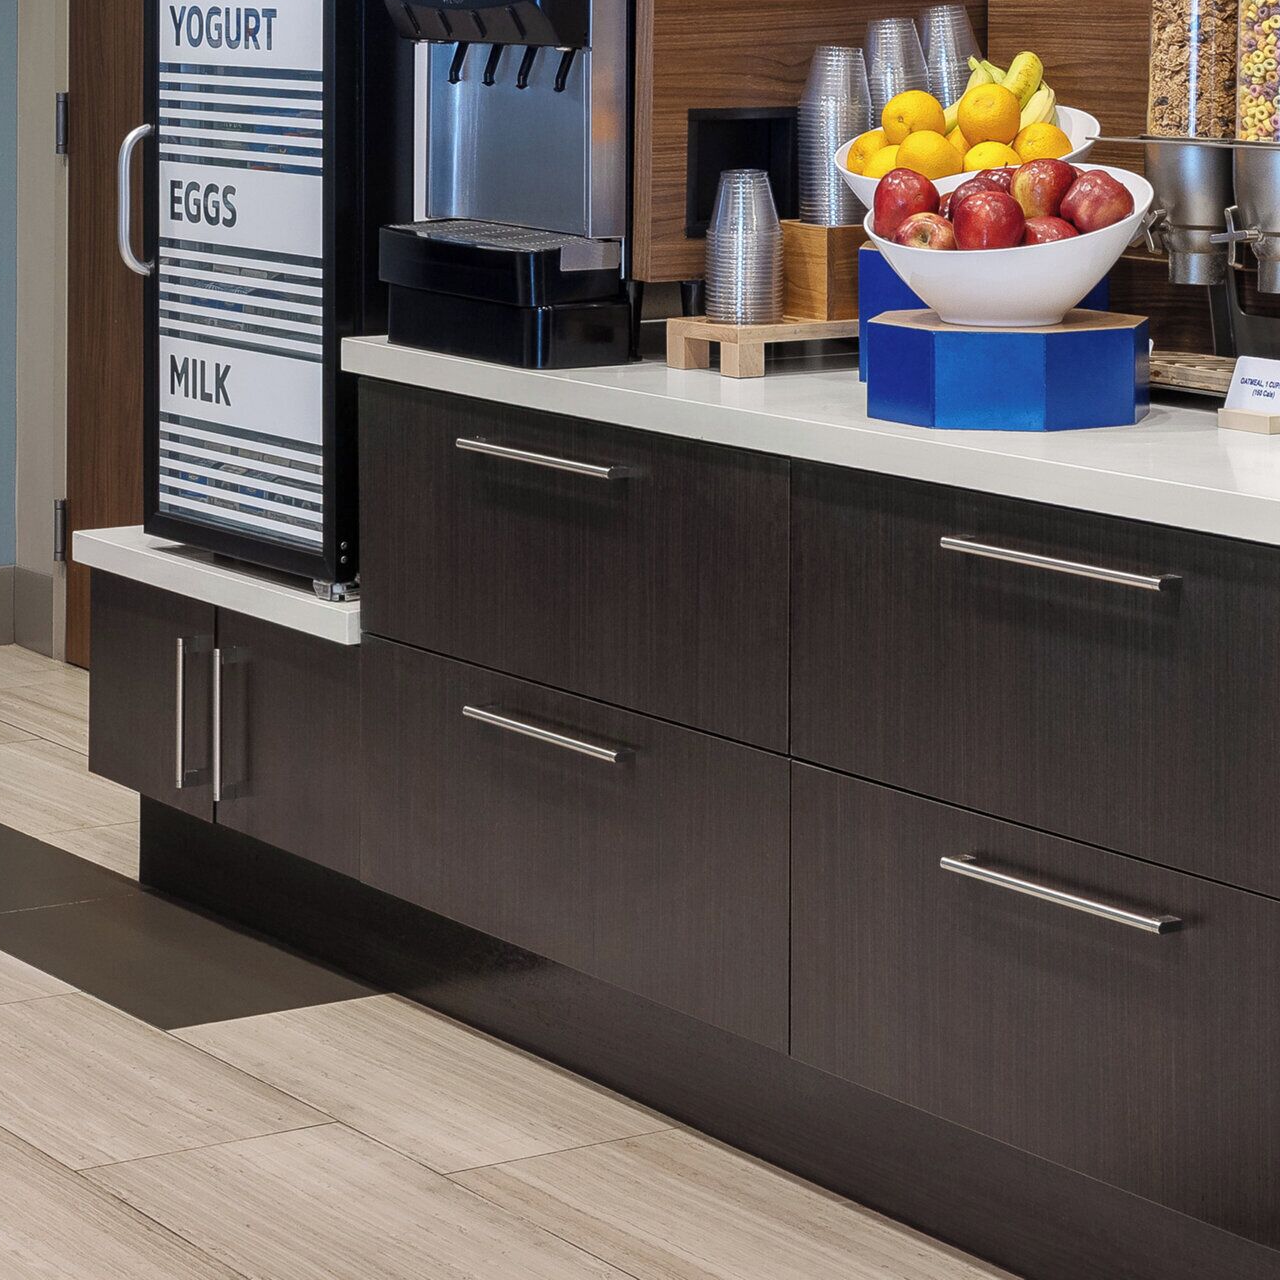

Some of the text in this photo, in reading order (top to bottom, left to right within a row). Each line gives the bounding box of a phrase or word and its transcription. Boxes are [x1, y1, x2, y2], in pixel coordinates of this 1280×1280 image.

[169, 5, 278, 51] YOGURT
[170, 179, 238, 228] EGGS
[169, 353, 232, 407] MILK
